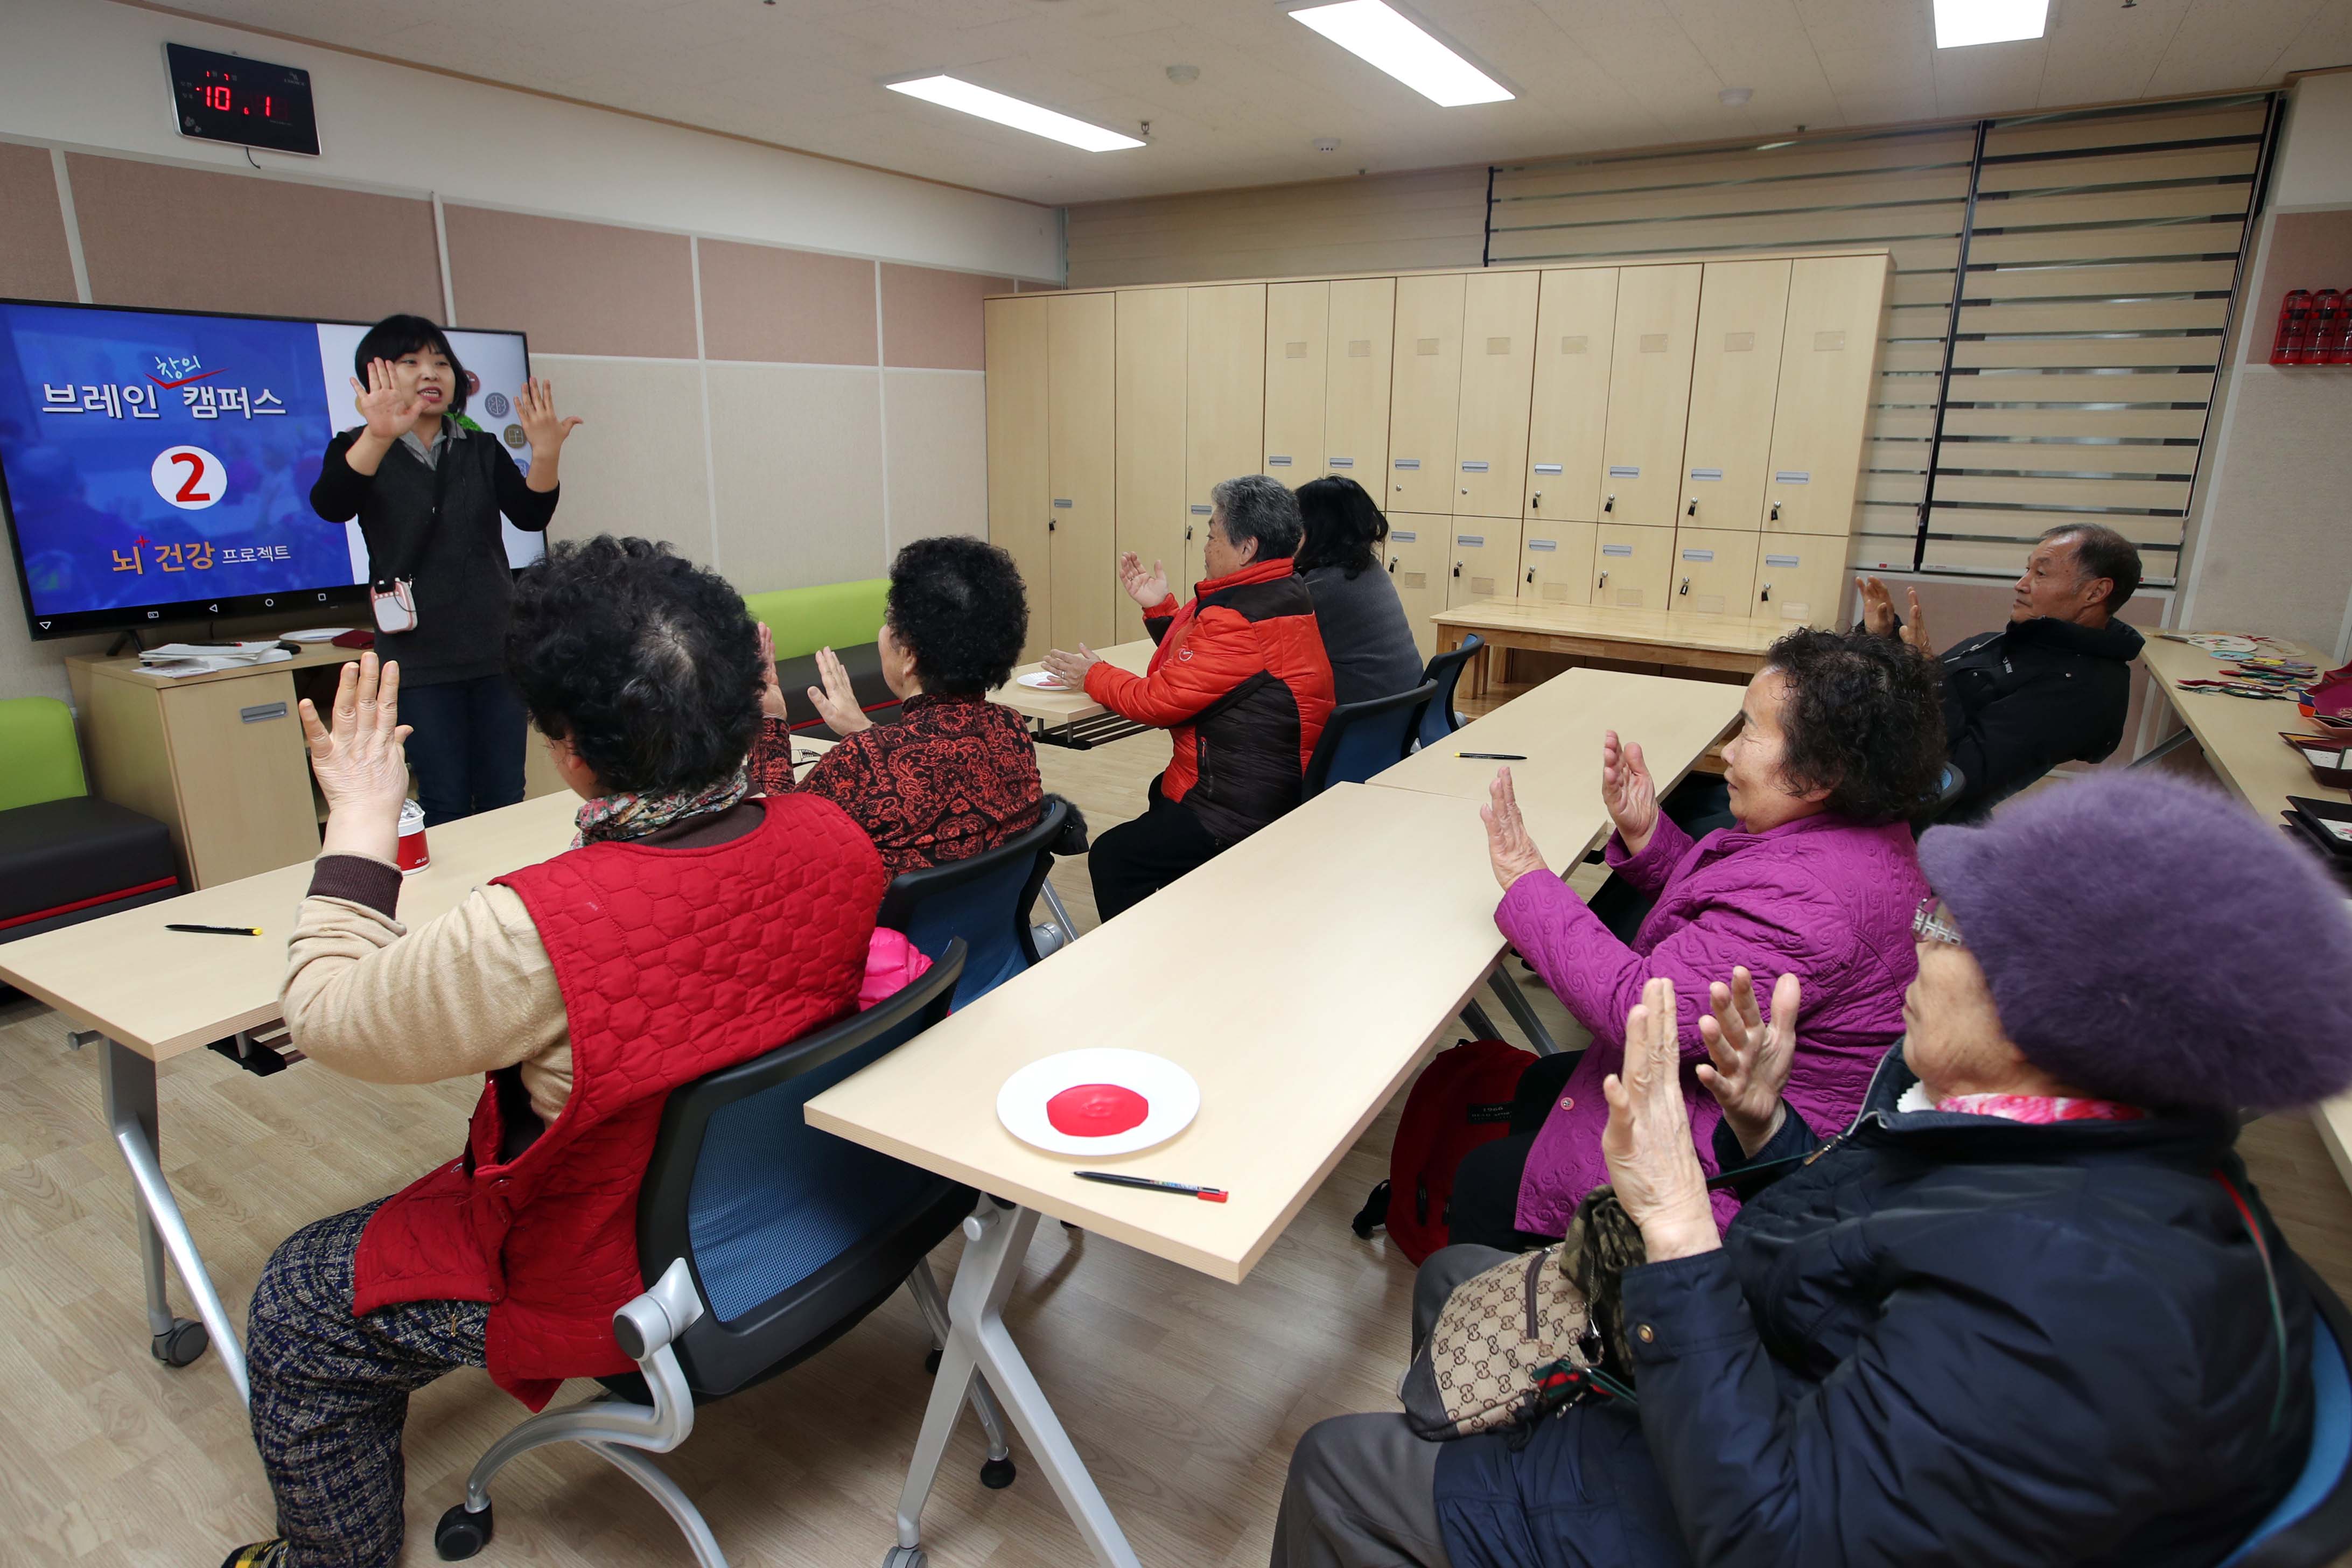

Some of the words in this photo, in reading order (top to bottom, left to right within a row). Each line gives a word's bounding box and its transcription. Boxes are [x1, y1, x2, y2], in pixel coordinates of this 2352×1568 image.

[206, 86, 231, 111] 10
[155, 355, 201, 379] 창의
[42, 383, 160, 419] 브레인
[183, 386, 286, 419] 캠퍼스
[170, 452, 211, 502] 2
[112, 545, 143, 575] 뇌
[154, 541, 215, 572] 건강
[222, 545, 291, 564] 프로젝트
